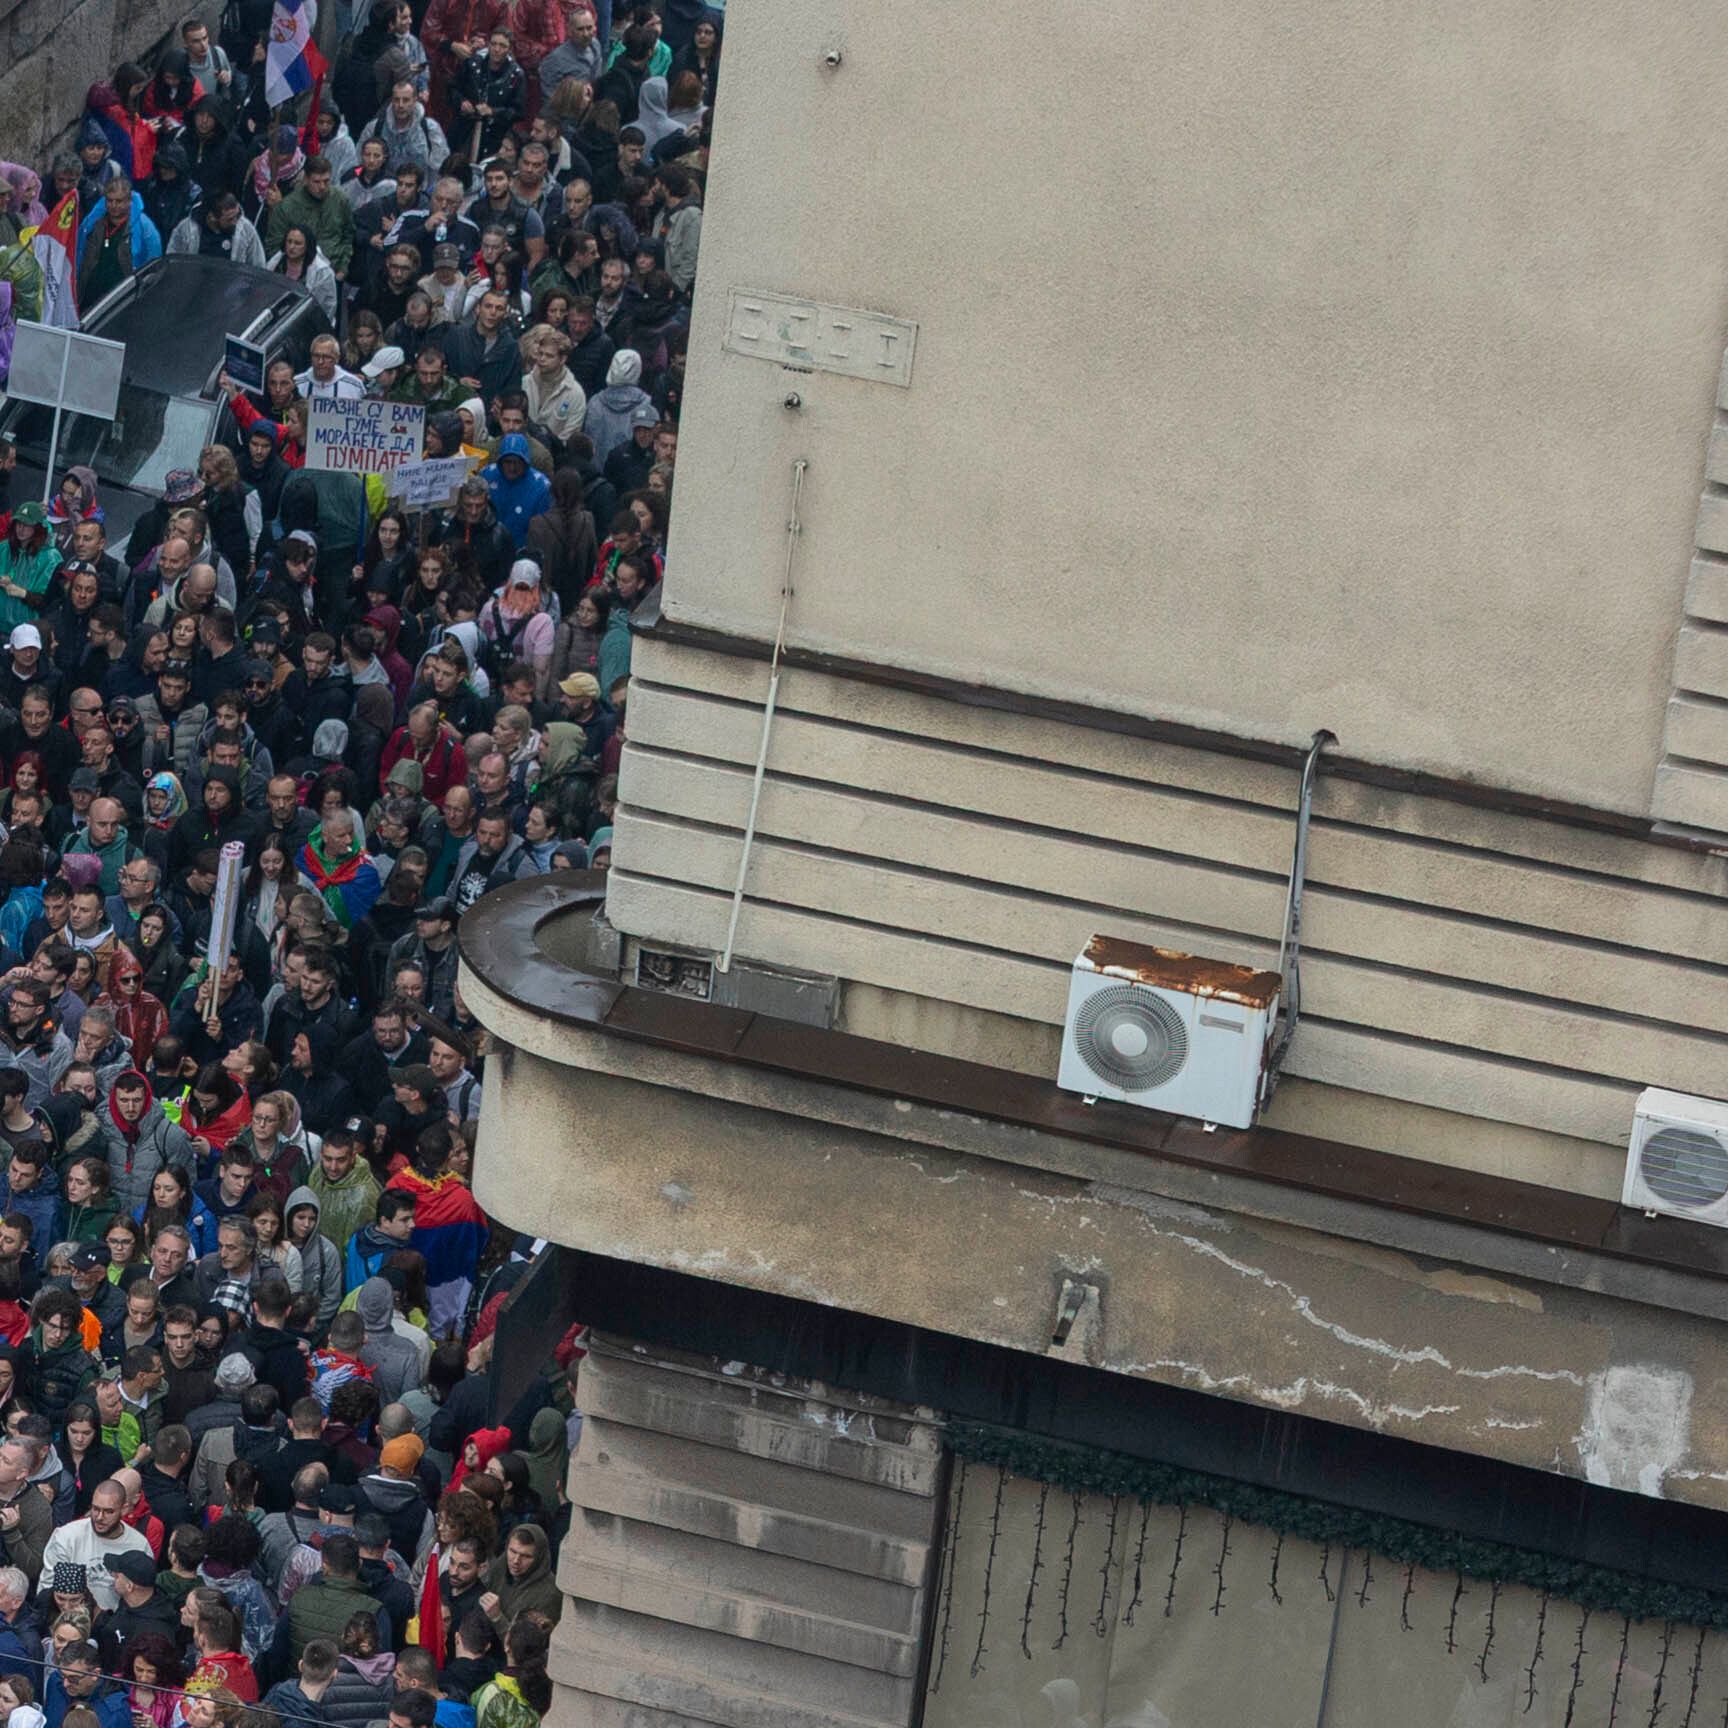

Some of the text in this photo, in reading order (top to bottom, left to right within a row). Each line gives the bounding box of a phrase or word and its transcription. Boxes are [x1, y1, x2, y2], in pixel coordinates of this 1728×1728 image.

[313, 399, 424, 423] ПРАЗНЕ СУ ВАМ
[345, 417, 382, 433] ГУМЕ
[390, 437, 414, 453] ДА
[326, 447, 411, 472] ПУМПАТЕ
